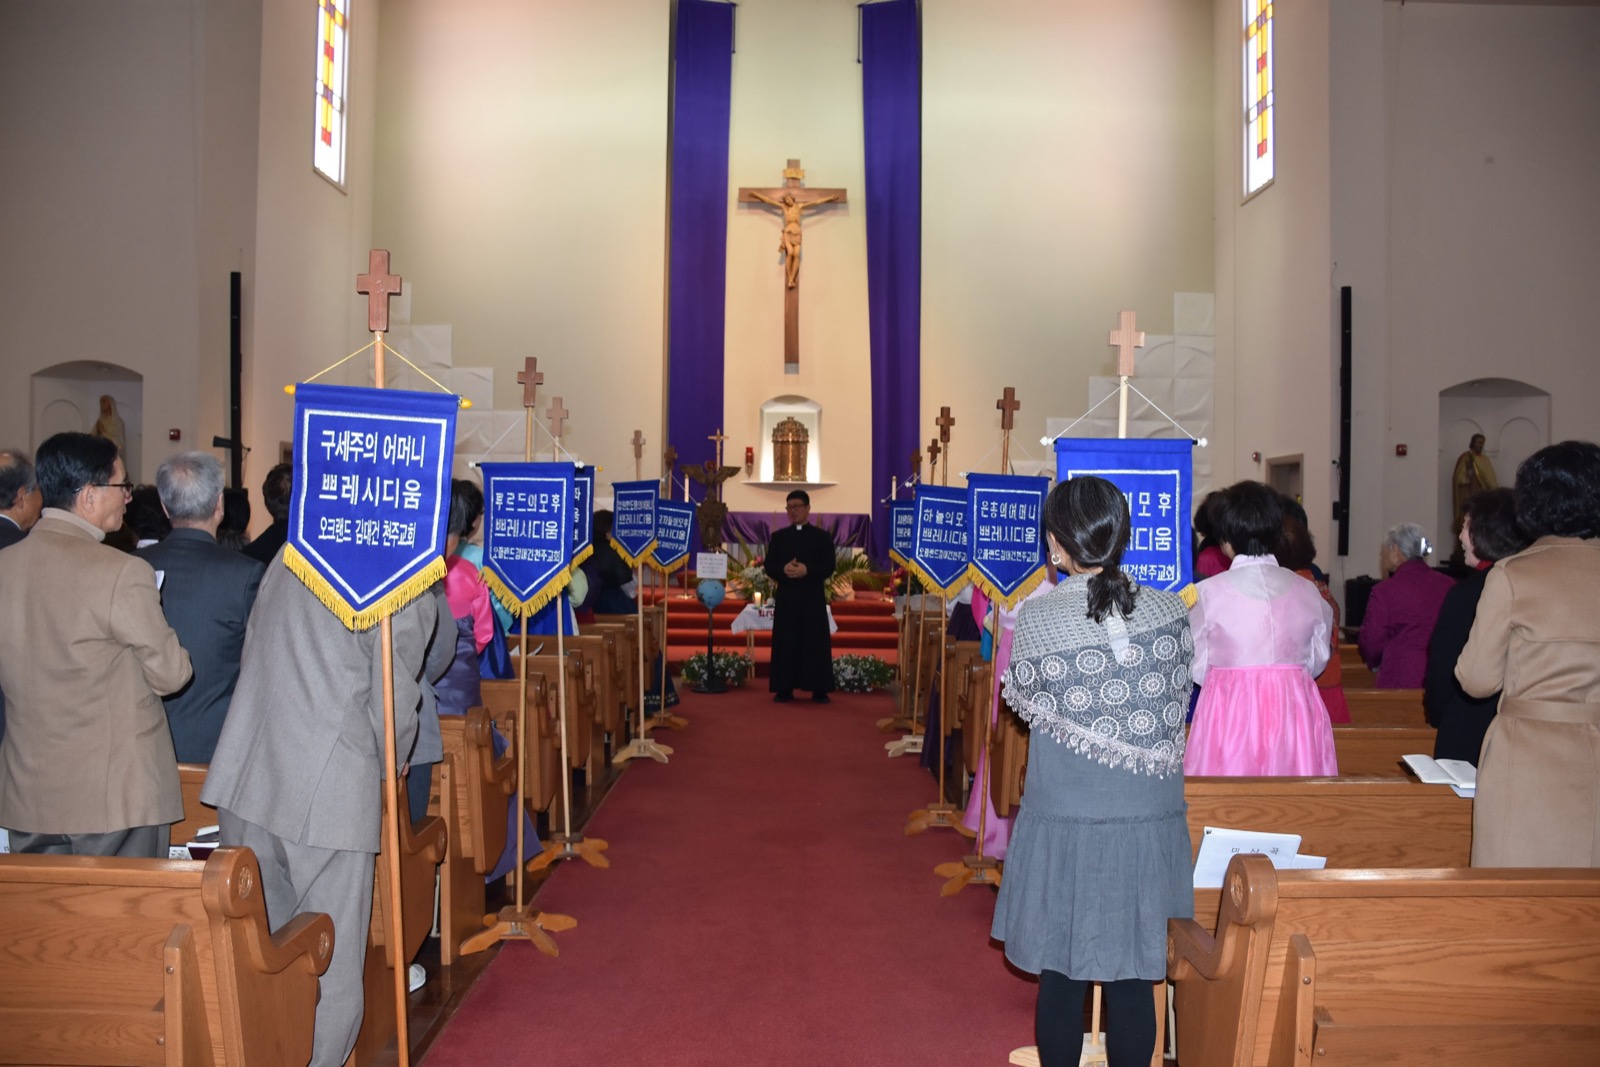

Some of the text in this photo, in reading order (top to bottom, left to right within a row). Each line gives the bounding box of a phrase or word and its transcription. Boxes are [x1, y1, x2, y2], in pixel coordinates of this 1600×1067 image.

[320, 429, 426, 468] 구세주의 어머니
[318, 473, 422, 510] 쁘레시디움
[494, 518, 559, 540] 쁘레시디움
[923, 508, 968, 527] 하늘의모
[318, 516, 417, 549] 오크랜드 김대건 천주교회
[978, 525, 1037, 544] 쁘레시디움
